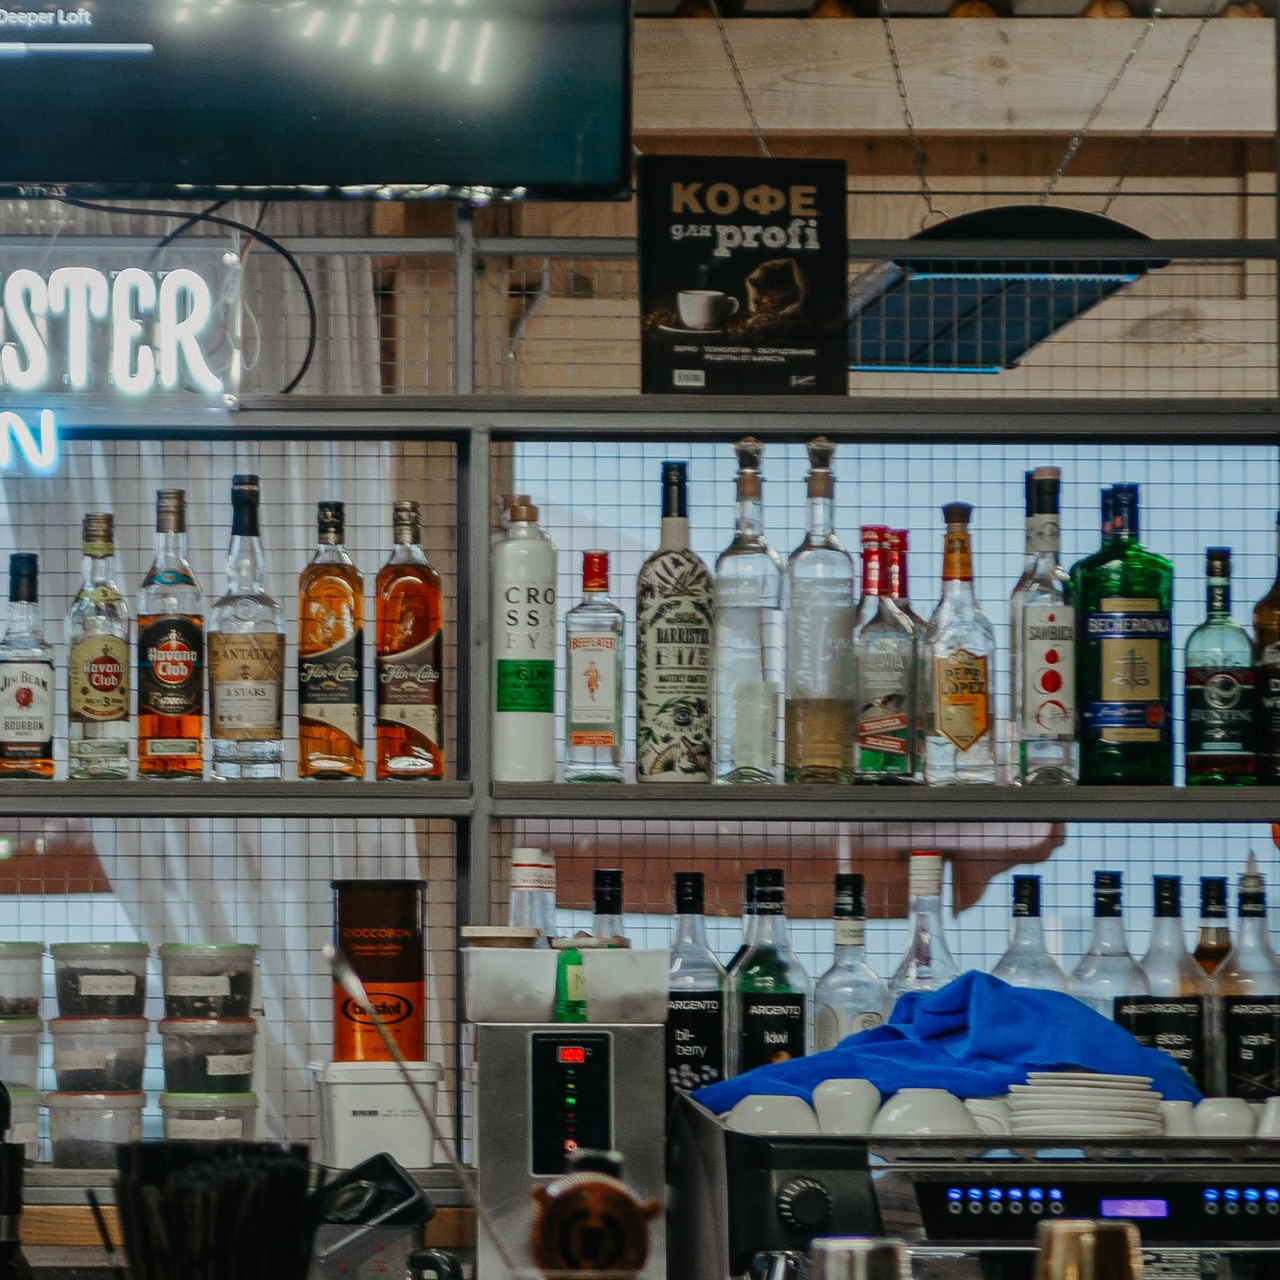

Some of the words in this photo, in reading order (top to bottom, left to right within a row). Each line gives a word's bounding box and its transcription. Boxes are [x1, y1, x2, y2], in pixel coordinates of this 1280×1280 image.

[57, 7, 93, 25] Loft
[671, 181, 819, 217] КОФЕ
[713, 219, 820, 257] profi
[572, 637, 616, 650] BEEFEATER
[147, 646, 198, 662] Havana
[211, 648, 280, 661] PLANTATION
[158, 662, 189, 677] Club
[20, 670, 48, 693] BEAM
[90, 674, 119, 686] Club
[233, 687, 267, 698] STARS
[4, 720, 45, 731] BOURBON
[352, 1000, 403, 1017] brstot
[668, 1000, 719, 1010] ARGENTO
[749, 1005, 801, 1015] ARGENTO
[763, 1030, 789, 1044] kiwi
